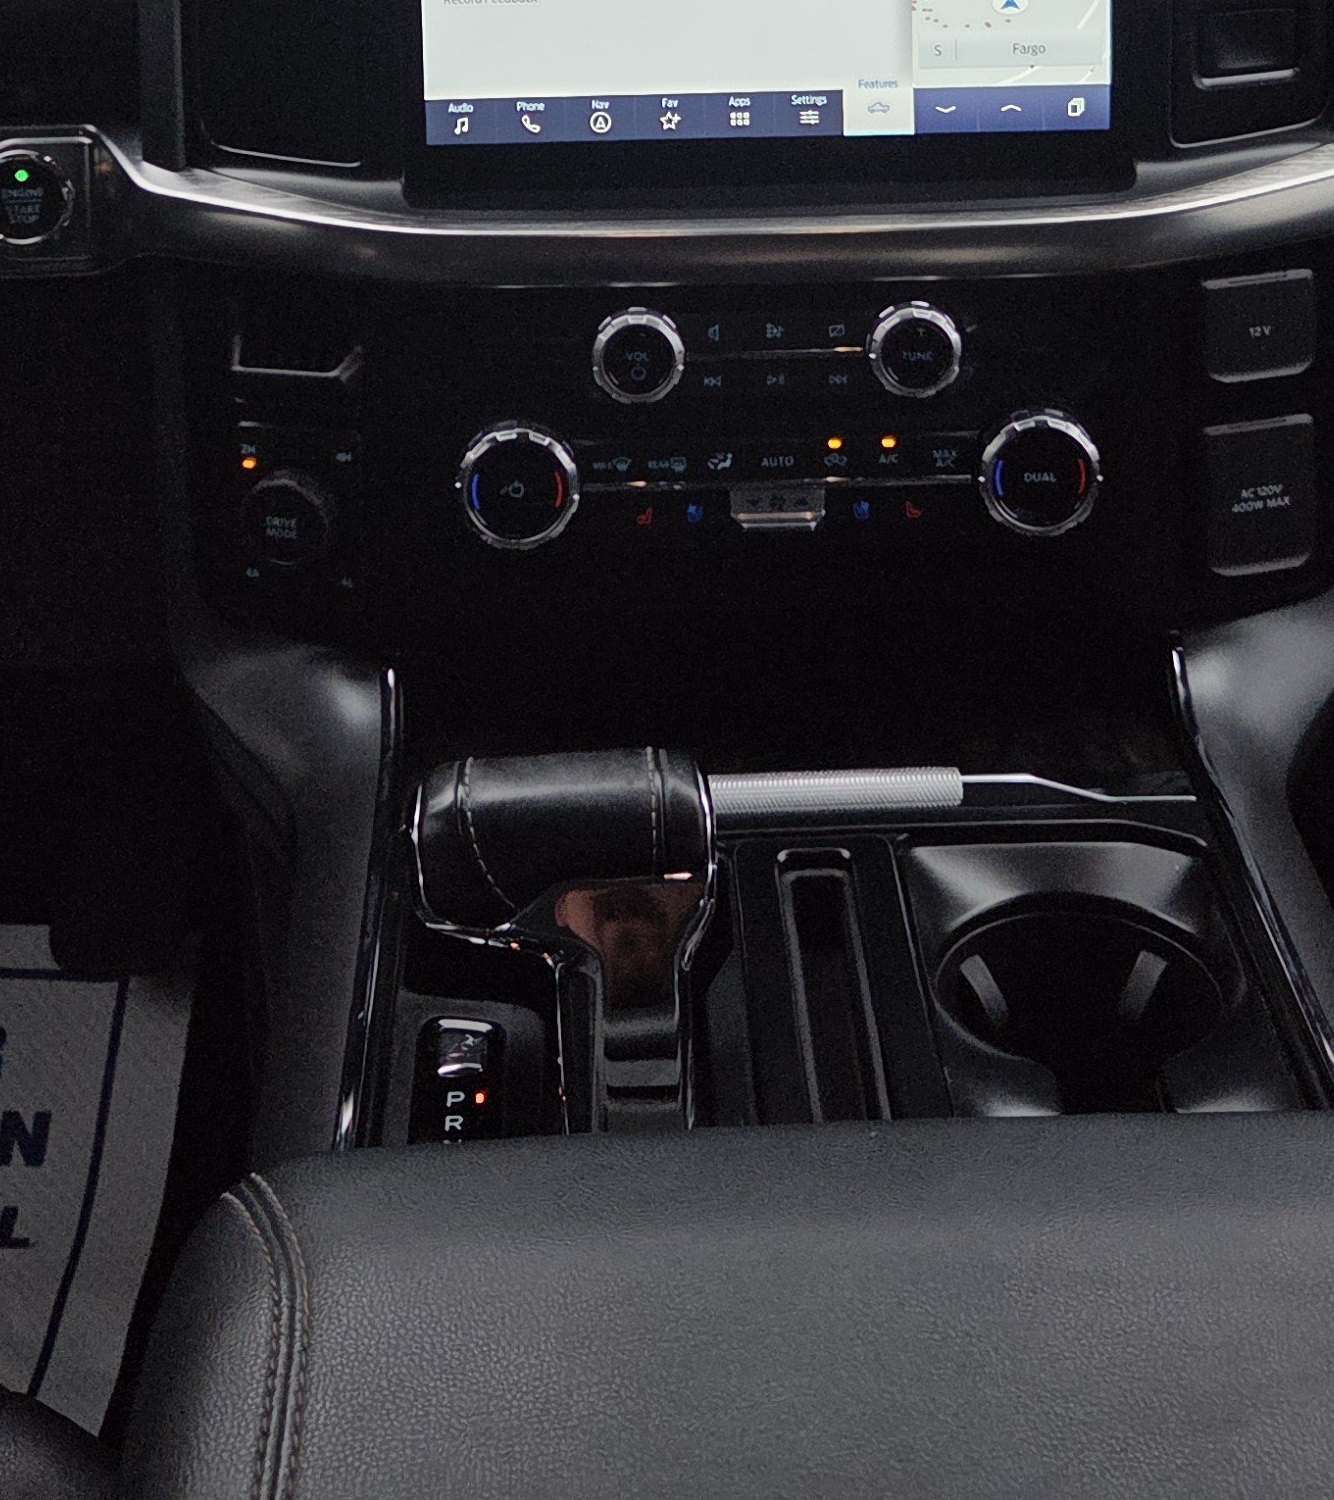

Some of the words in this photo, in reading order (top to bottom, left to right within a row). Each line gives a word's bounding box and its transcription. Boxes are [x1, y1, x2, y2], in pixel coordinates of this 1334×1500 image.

[1012, 43, 1047, 57] Fargo
[858, 78, 899, 90] Features
[516, 100, 546, 112] Phone
[591, 99, 610, 111] Nav
[661, 97, 679, 109] Fav
[728, 96, 751, 108] Apps
[790, 94, 828, 107] Settings
[448, 102, 474, 114] Audio
[626, 351, 649, 363] VOL
[761, 455, 794, 467] AUTO
[1023, 471, 1057, 483] DUAL
[446, 1091, 465, 1108] P
[445, 1115, 464, 1132] R
